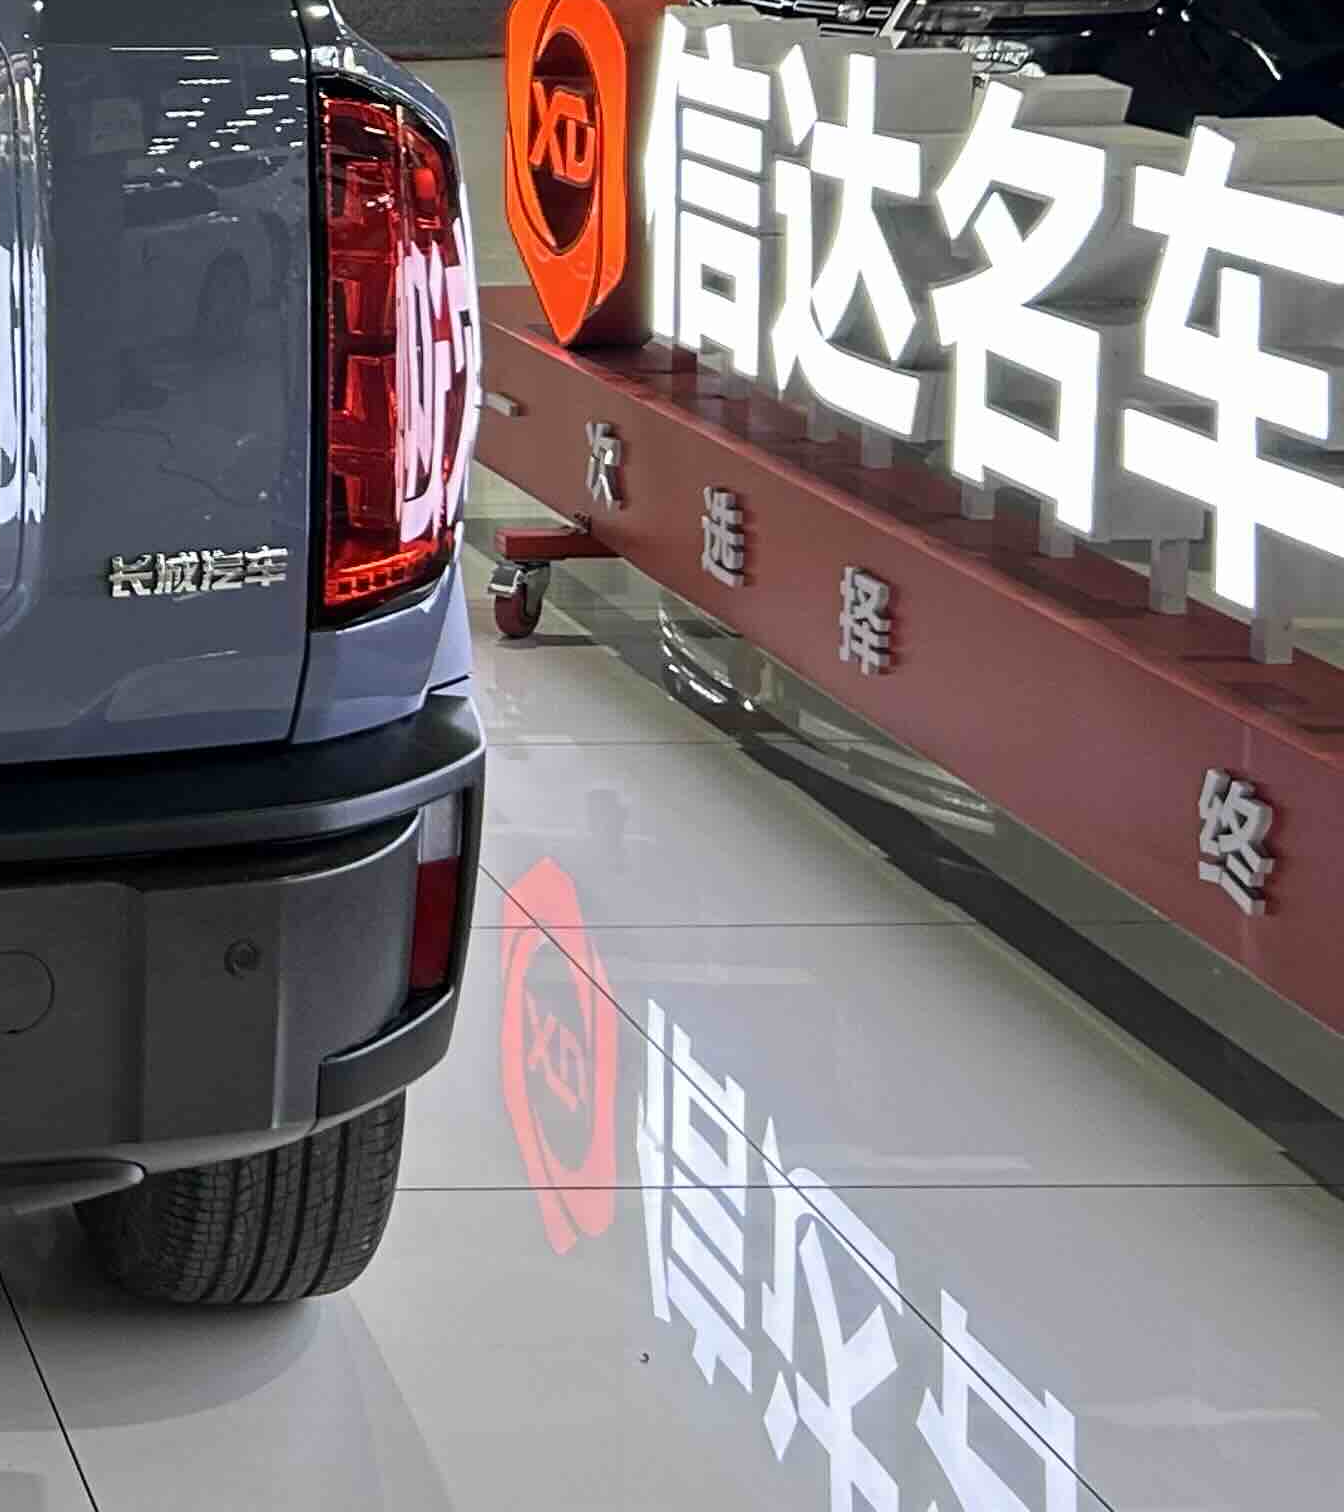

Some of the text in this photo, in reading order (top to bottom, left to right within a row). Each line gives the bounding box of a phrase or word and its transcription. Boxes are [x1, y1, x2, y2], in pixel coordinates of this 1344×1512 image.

[644, 10, 1344, 610] 信达名车
[109, 545, 288, 598] 长城汽车
[1198, 767, 1284, 915] 终
